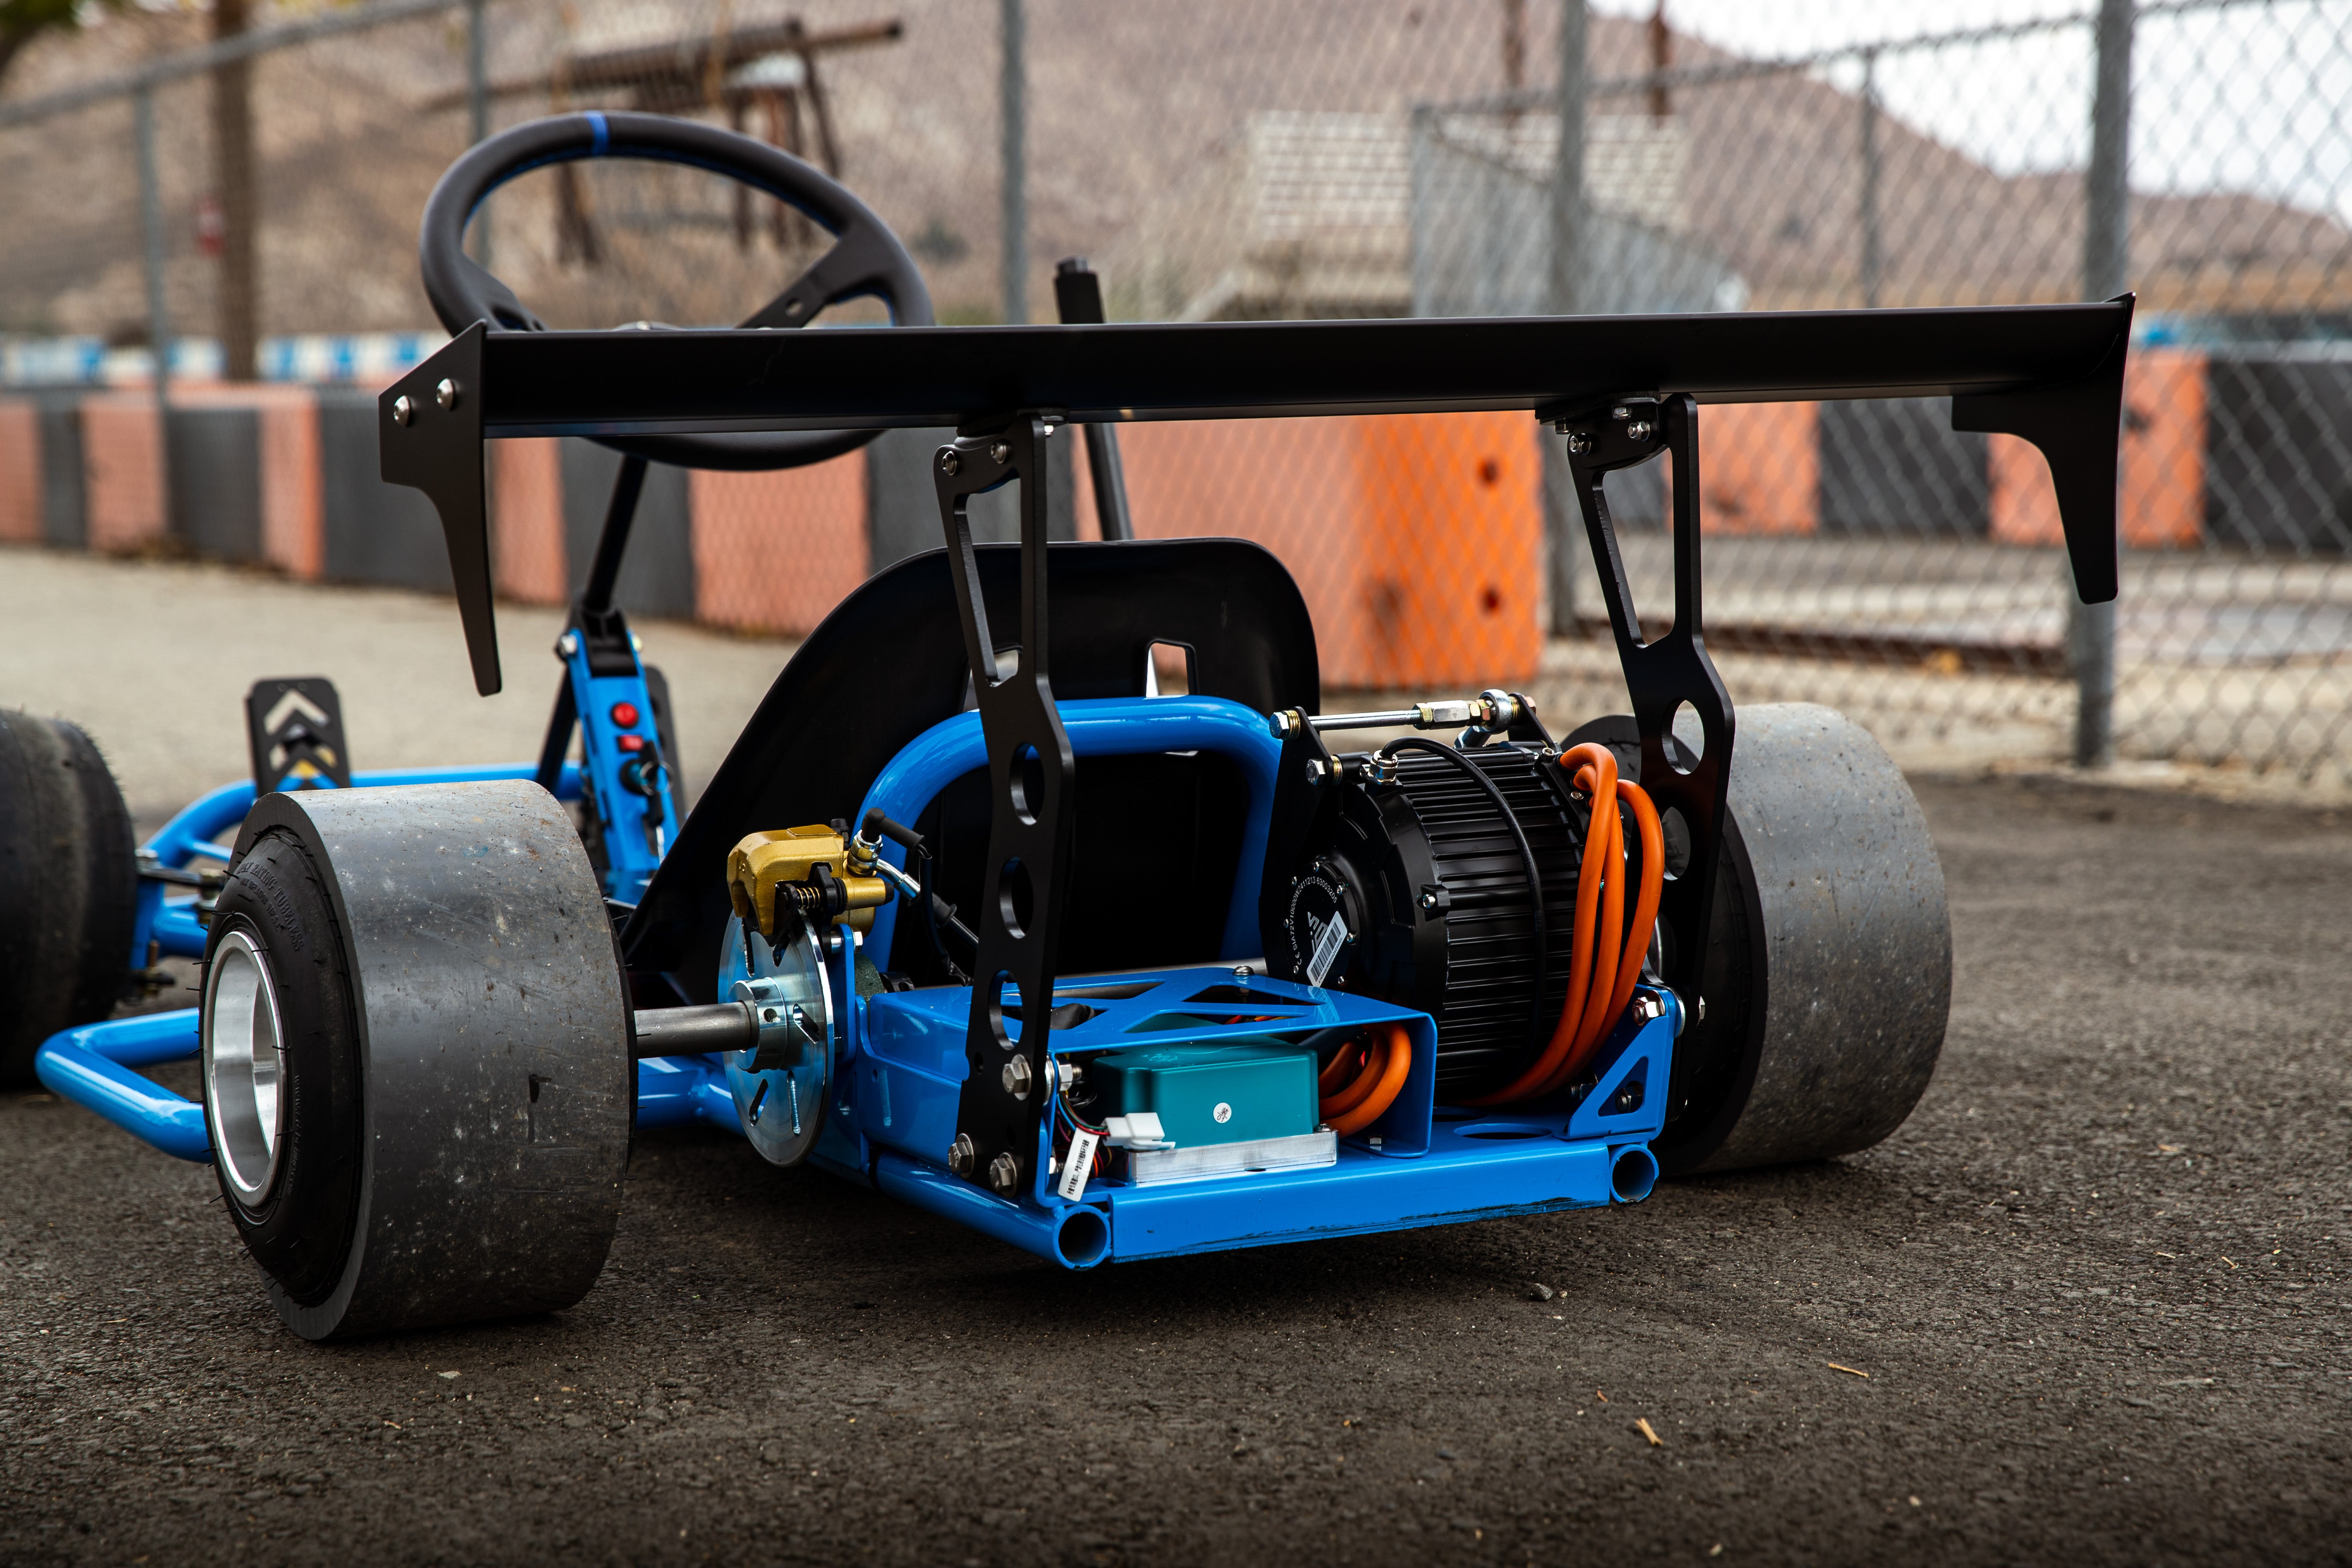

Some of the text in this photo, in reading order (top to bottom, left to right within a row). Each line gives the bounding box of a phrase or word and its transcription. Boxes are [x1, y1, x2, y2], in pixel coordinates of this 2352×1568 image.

[249, 864, 277, 891] RATING
[274, 886, 304, 951] TUBELESS
[1317, 877, 1338, 903] 63003205
